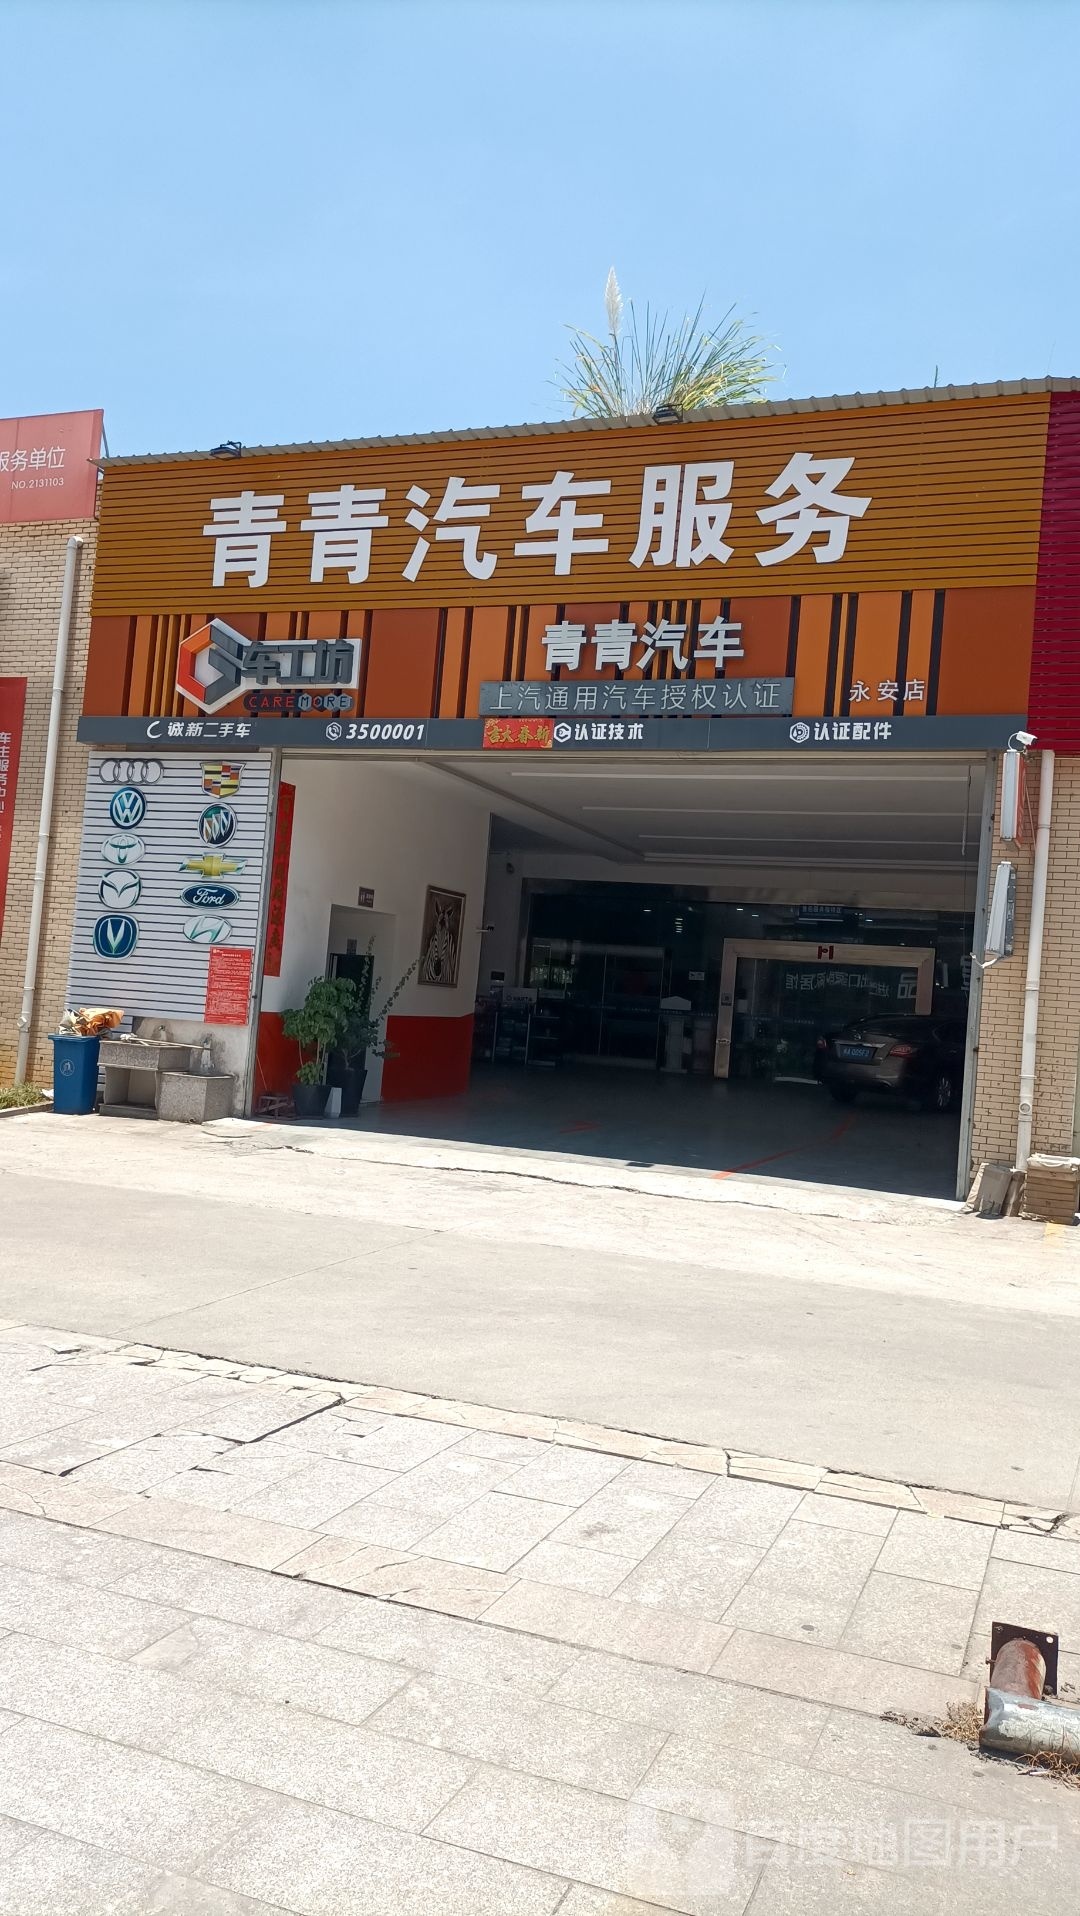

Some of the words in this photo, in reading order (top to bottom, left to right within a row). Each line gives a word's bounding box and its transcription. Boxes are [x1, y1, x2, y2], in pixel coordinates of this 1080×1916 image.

[0, 446, 66, 472] 服务单位
[203, 452, 872, 588] 青青汽车服务
[541, 615, 745, 673] 青青汽车
[241, 639, 355, 685] 车工坊
[489, 682, 781, 711] 上汽通用汽车授权认证
[849, 679, 925, 702] 永安店
[167, 721, 252, 738] 诚新二手车
[346, 723, 425, 741] 3500001
[573, 722, 644, 741] 认证技术
[814, 721, 892, 741] 认证配件
[192, 887, 226, 905] Ford
